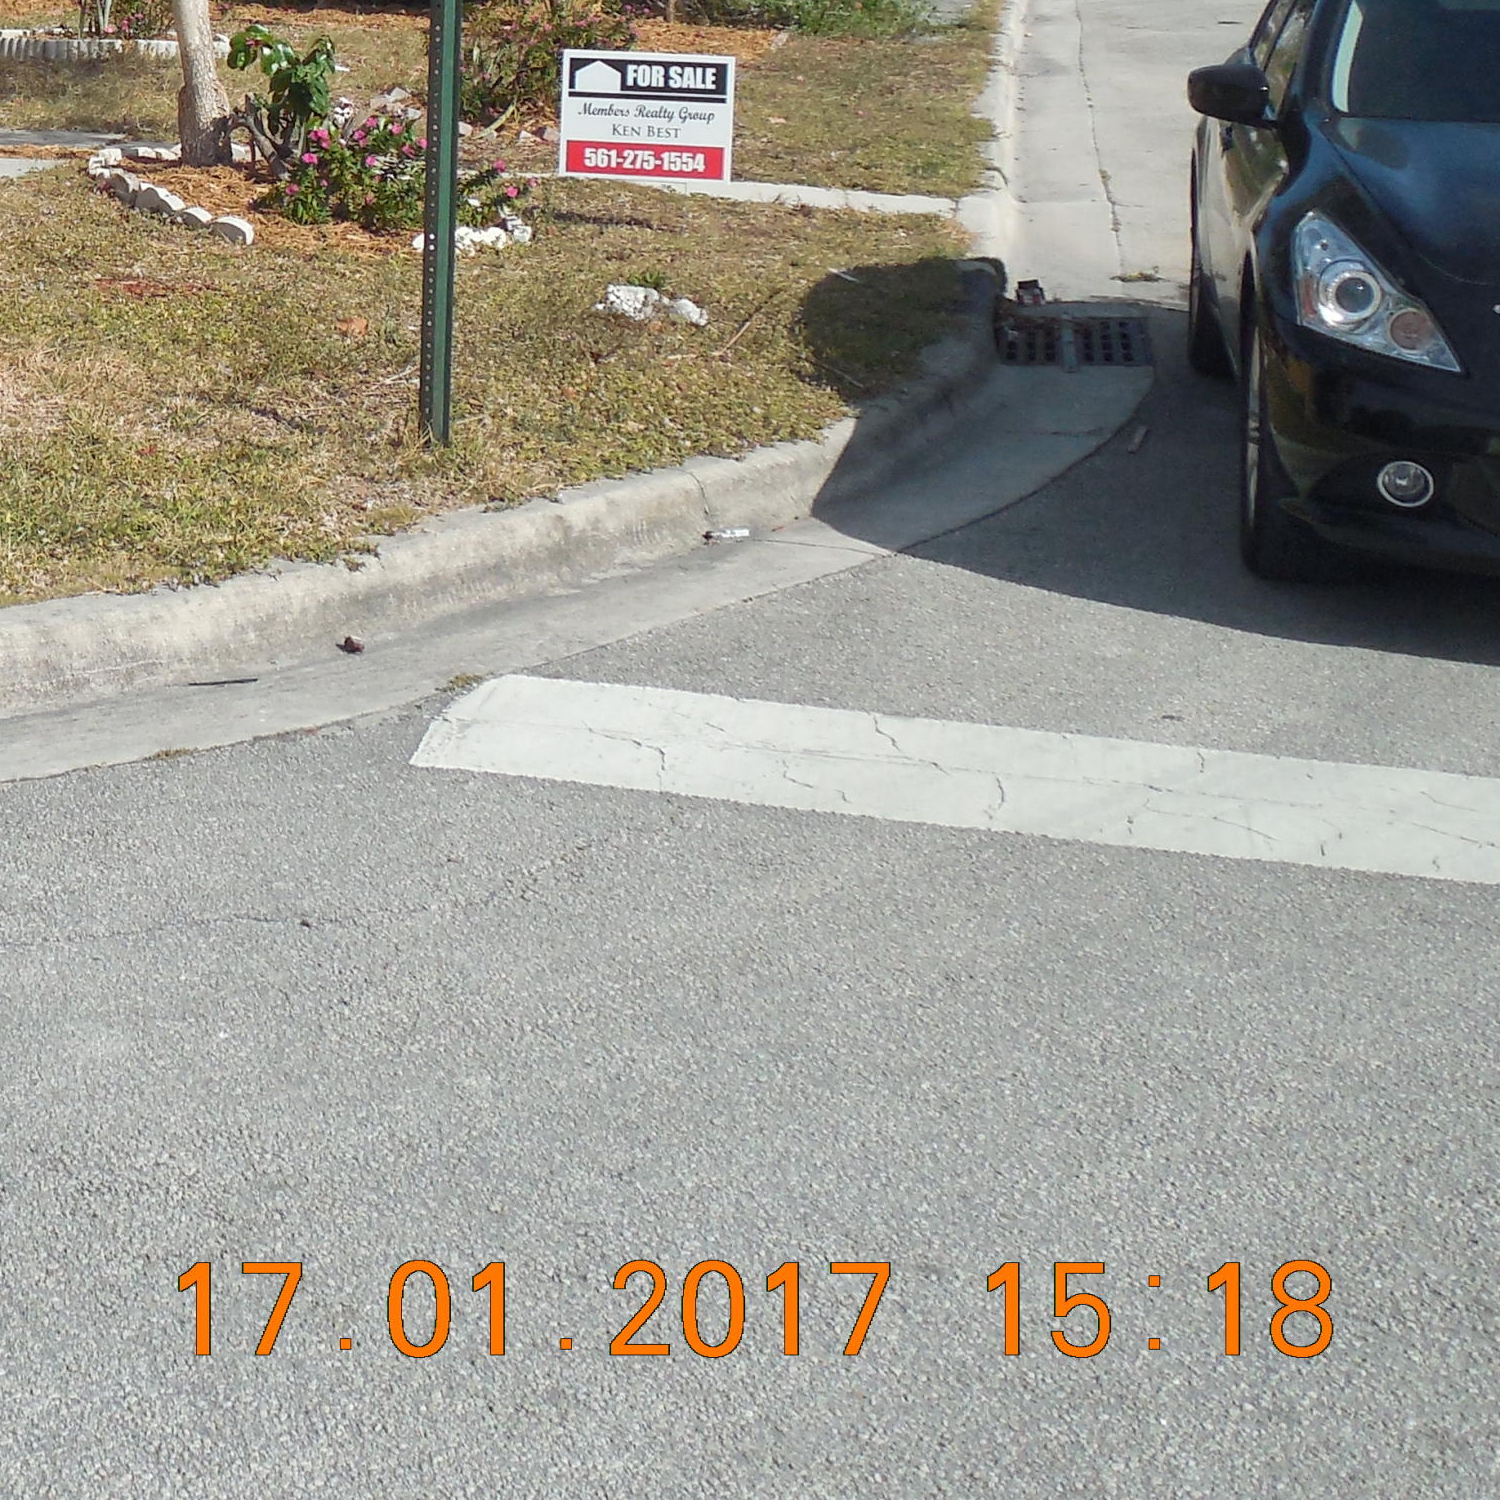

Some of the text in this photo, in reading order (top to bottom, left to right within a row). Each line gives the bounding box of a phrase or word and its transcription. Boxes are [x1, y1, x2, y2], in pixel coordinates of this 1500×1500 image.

[626, 64, 717, 90] FOR SALE
[578, 102, 715, 125] Members Realty Group
[584, 147, 705, 173] 561-275-1554
